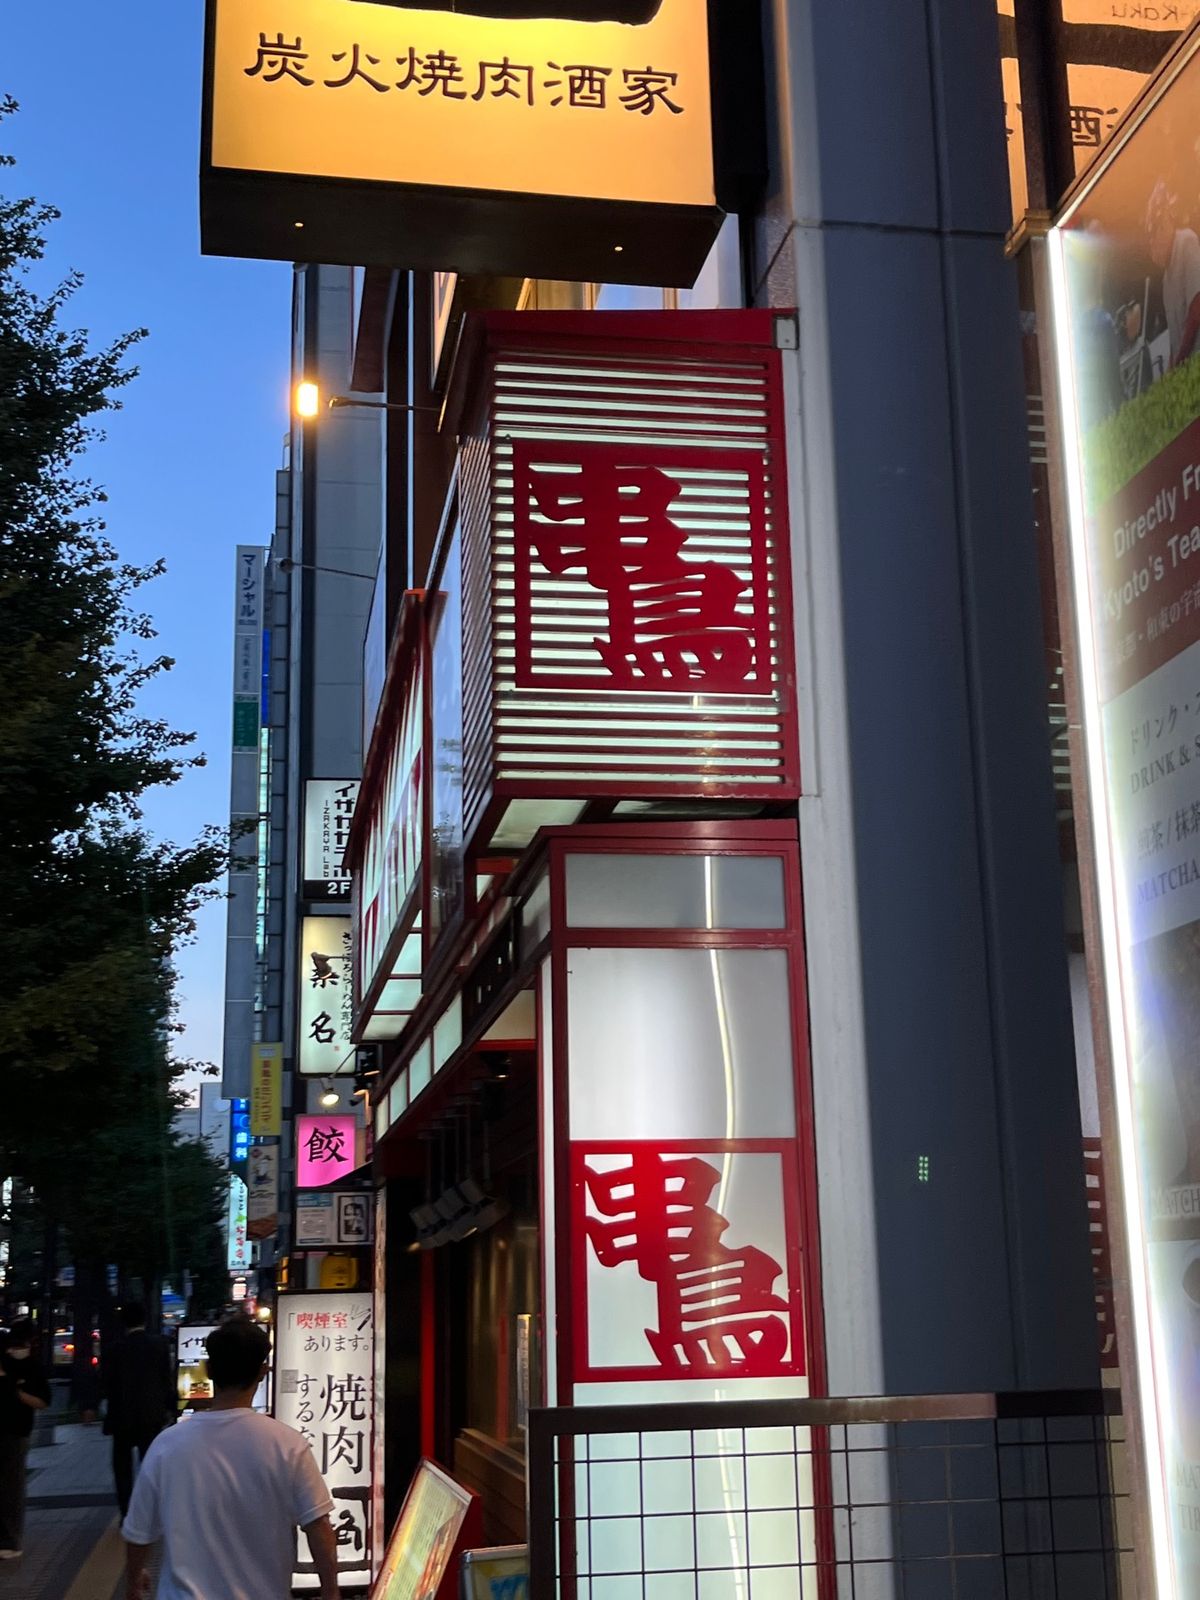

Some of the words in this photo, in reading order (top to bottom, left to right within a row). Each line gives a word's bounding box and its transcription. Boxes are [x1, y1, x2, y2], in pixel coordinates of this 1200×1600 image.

[243, 31, 684, 115] 炭火焼肉酒家
[1113, 486, 1177, 559] Directly
[241, 553, 256, 617] マーシャル
[1130, 750, 1176, 794] DRINK
[327, 881, 351, 895] 2F
[304, 1126, 349, 1164] 餃
[303, 1334, 370, 1352] あります。
[319, 1373, 367, 1475] 焼肉
